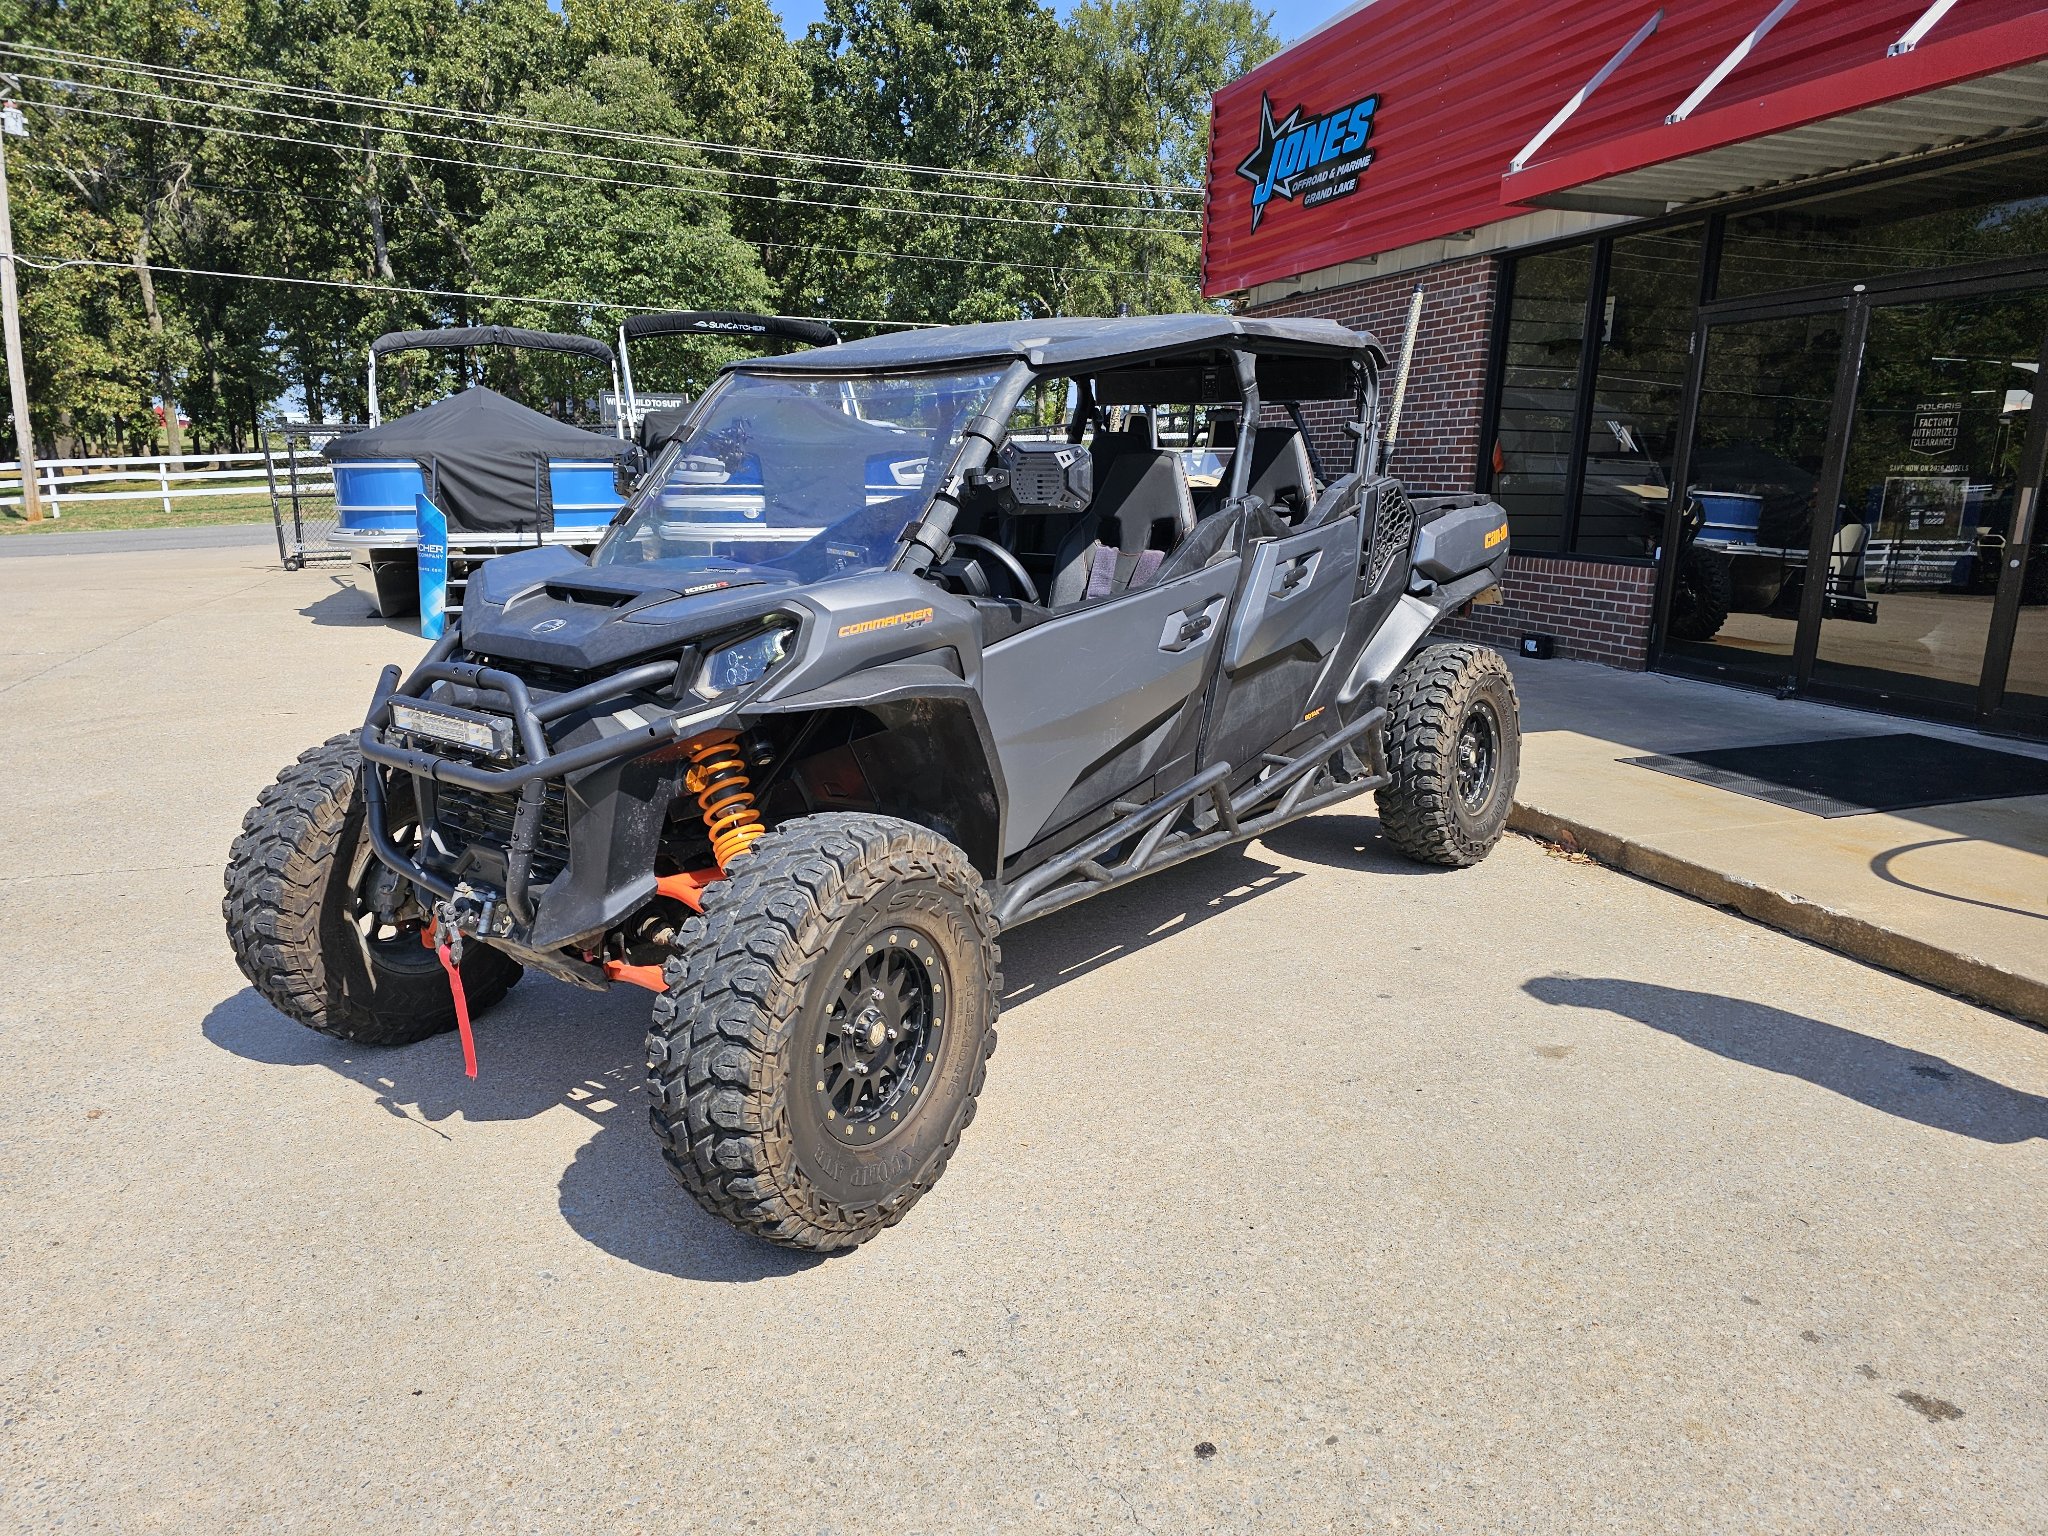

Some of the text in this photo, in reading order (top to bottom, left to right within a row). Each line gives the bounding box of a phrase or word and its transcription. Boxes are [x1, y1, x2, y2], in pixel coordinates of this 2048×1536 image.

[1252, 98, 1377, 206] JONES
[1291, 154, 1372, 192] OFFROAD & MARINE
[1304, 178, 1356, 205] GRAND LAKE
[662, 400, 682, 408] SUIT
[1916, 402, 1962, 411] POLARIS
[1919, 417, 1954, 427] FACTORY
[1912, 427, 1959, 437] AUTHORIZED
[1913, 437, 1953, 447] CLEARANCE
[1889, 464, 1904, 472] SAVE
[1905, 464, 1919, 472] NOW
[838, 607, 933, 638] COMMANDER
